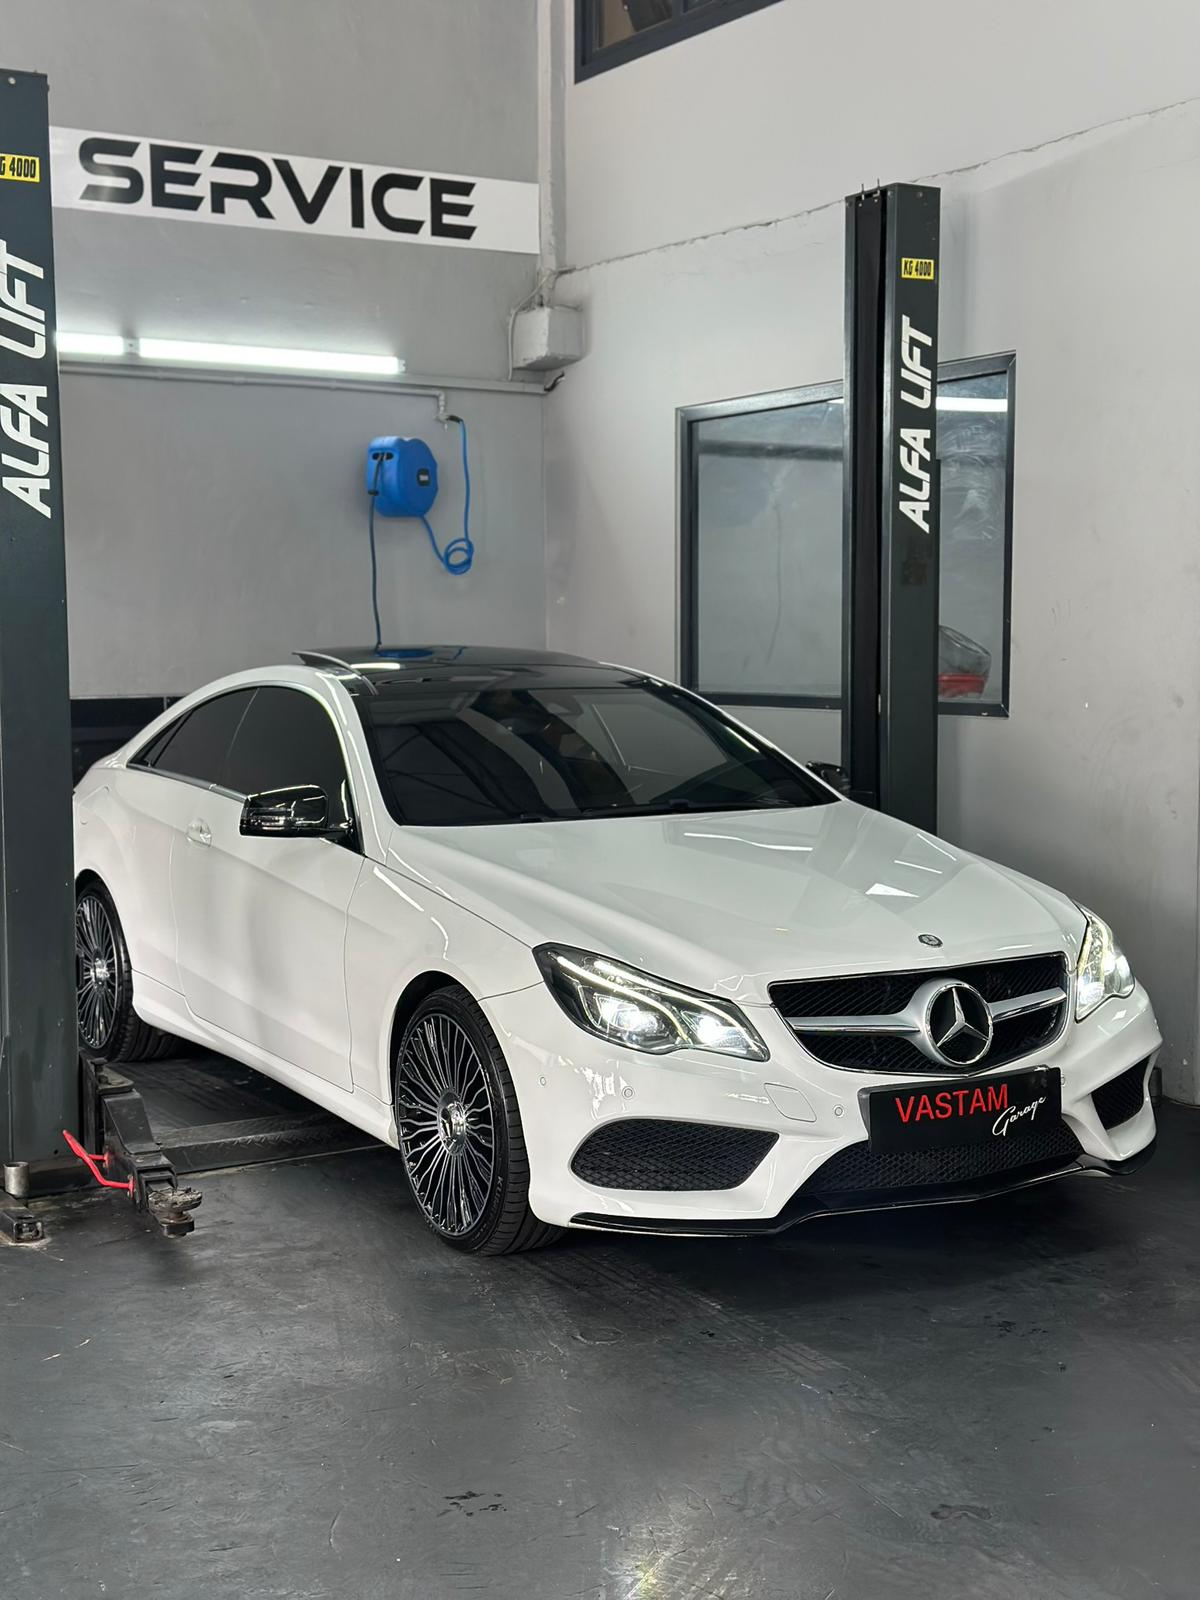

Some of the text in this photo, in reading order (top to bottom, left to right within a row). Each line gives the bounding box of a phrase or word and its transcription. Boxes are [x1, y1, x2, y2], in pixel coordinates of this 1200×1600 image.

[9, 156, 36, 178] 4000
[78, 137, 477, 240] SERVICE
[903, 259, 932, 276] KG 4000
[0, 238, 51, 519] ALFA LIFT
[899, 314, 933, 534] ALFA LIFT
[895, 1083, 1009, 1123] VASTAM
[992, 1096, 1046, 1136] Garage
